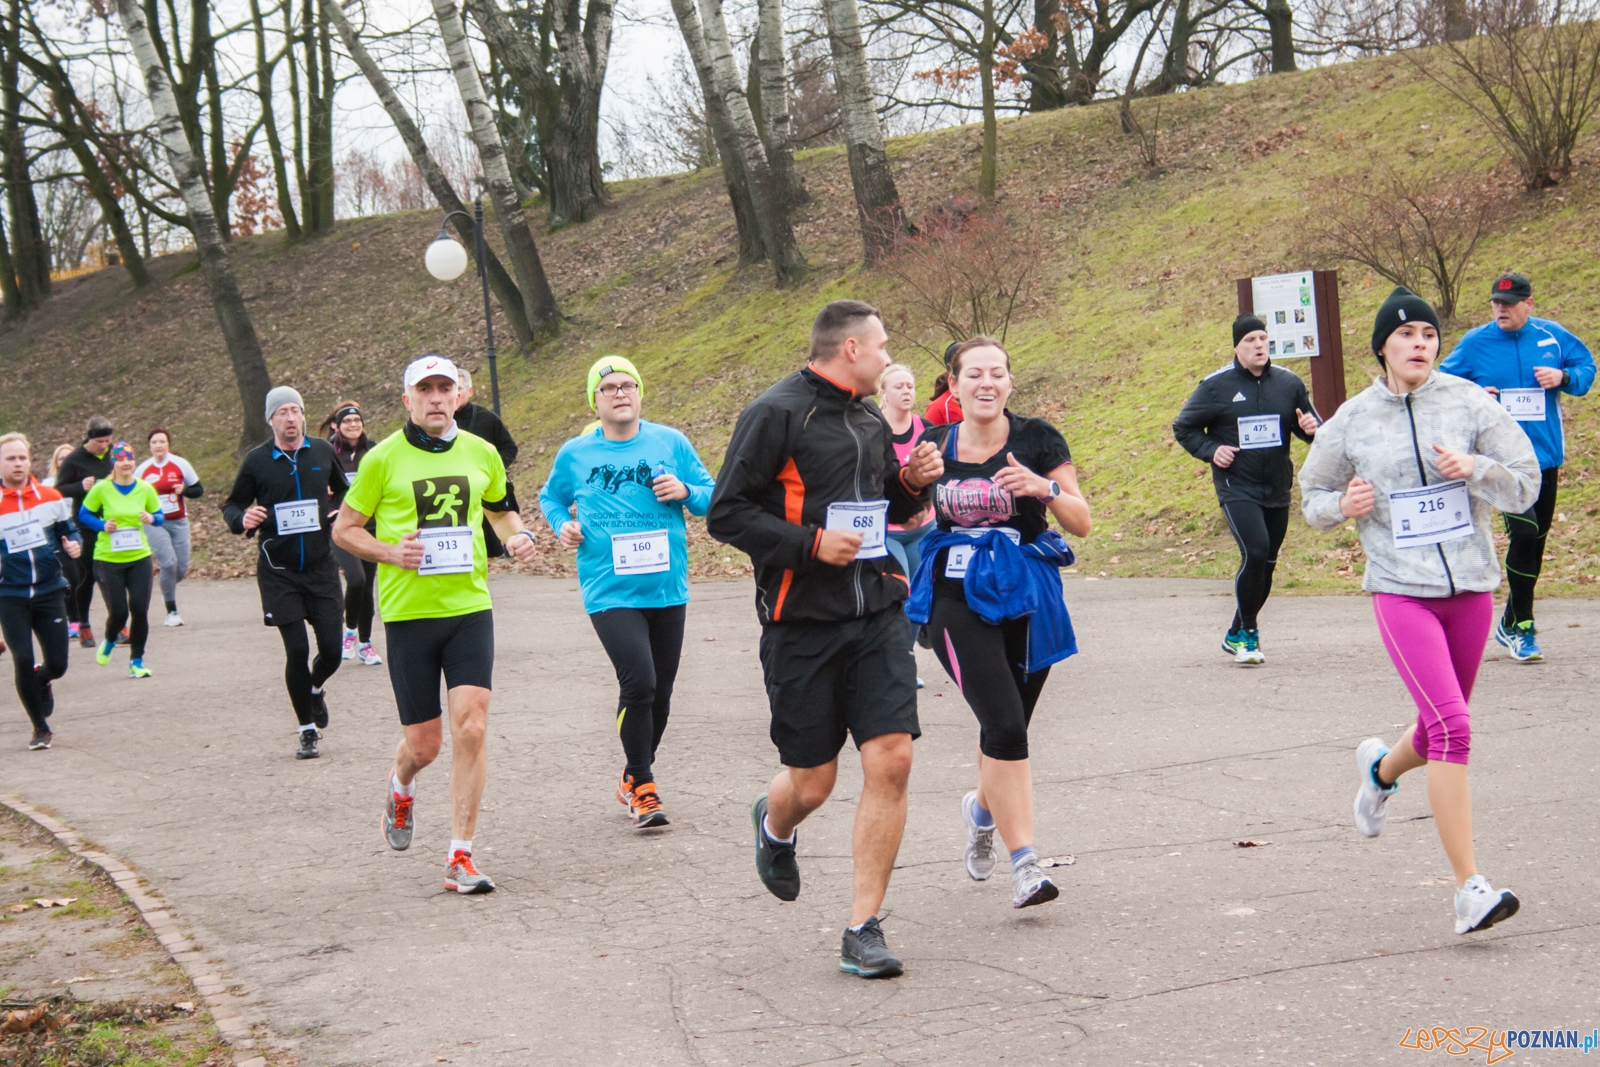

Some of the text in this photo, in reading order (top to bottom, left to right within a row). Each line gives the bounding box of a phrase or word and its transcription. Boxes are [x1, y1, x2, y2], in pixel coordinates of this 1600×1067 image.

[1516, 395, 1531, 403] 476
[1253, 424, 1268, 432] 475
[1418, 497, 1445, 513] 216
[291, 509, 306, 517] 715
[624, 511, 654, 520] GRAND
[657, 512, 673, 520] PRIX
[611, 520, 658, 528] SZYDŁOWO
[853, 515, 874, 528] 688
[437, 539, 457, 551] 913
[632, 541, 651, 552] 160
